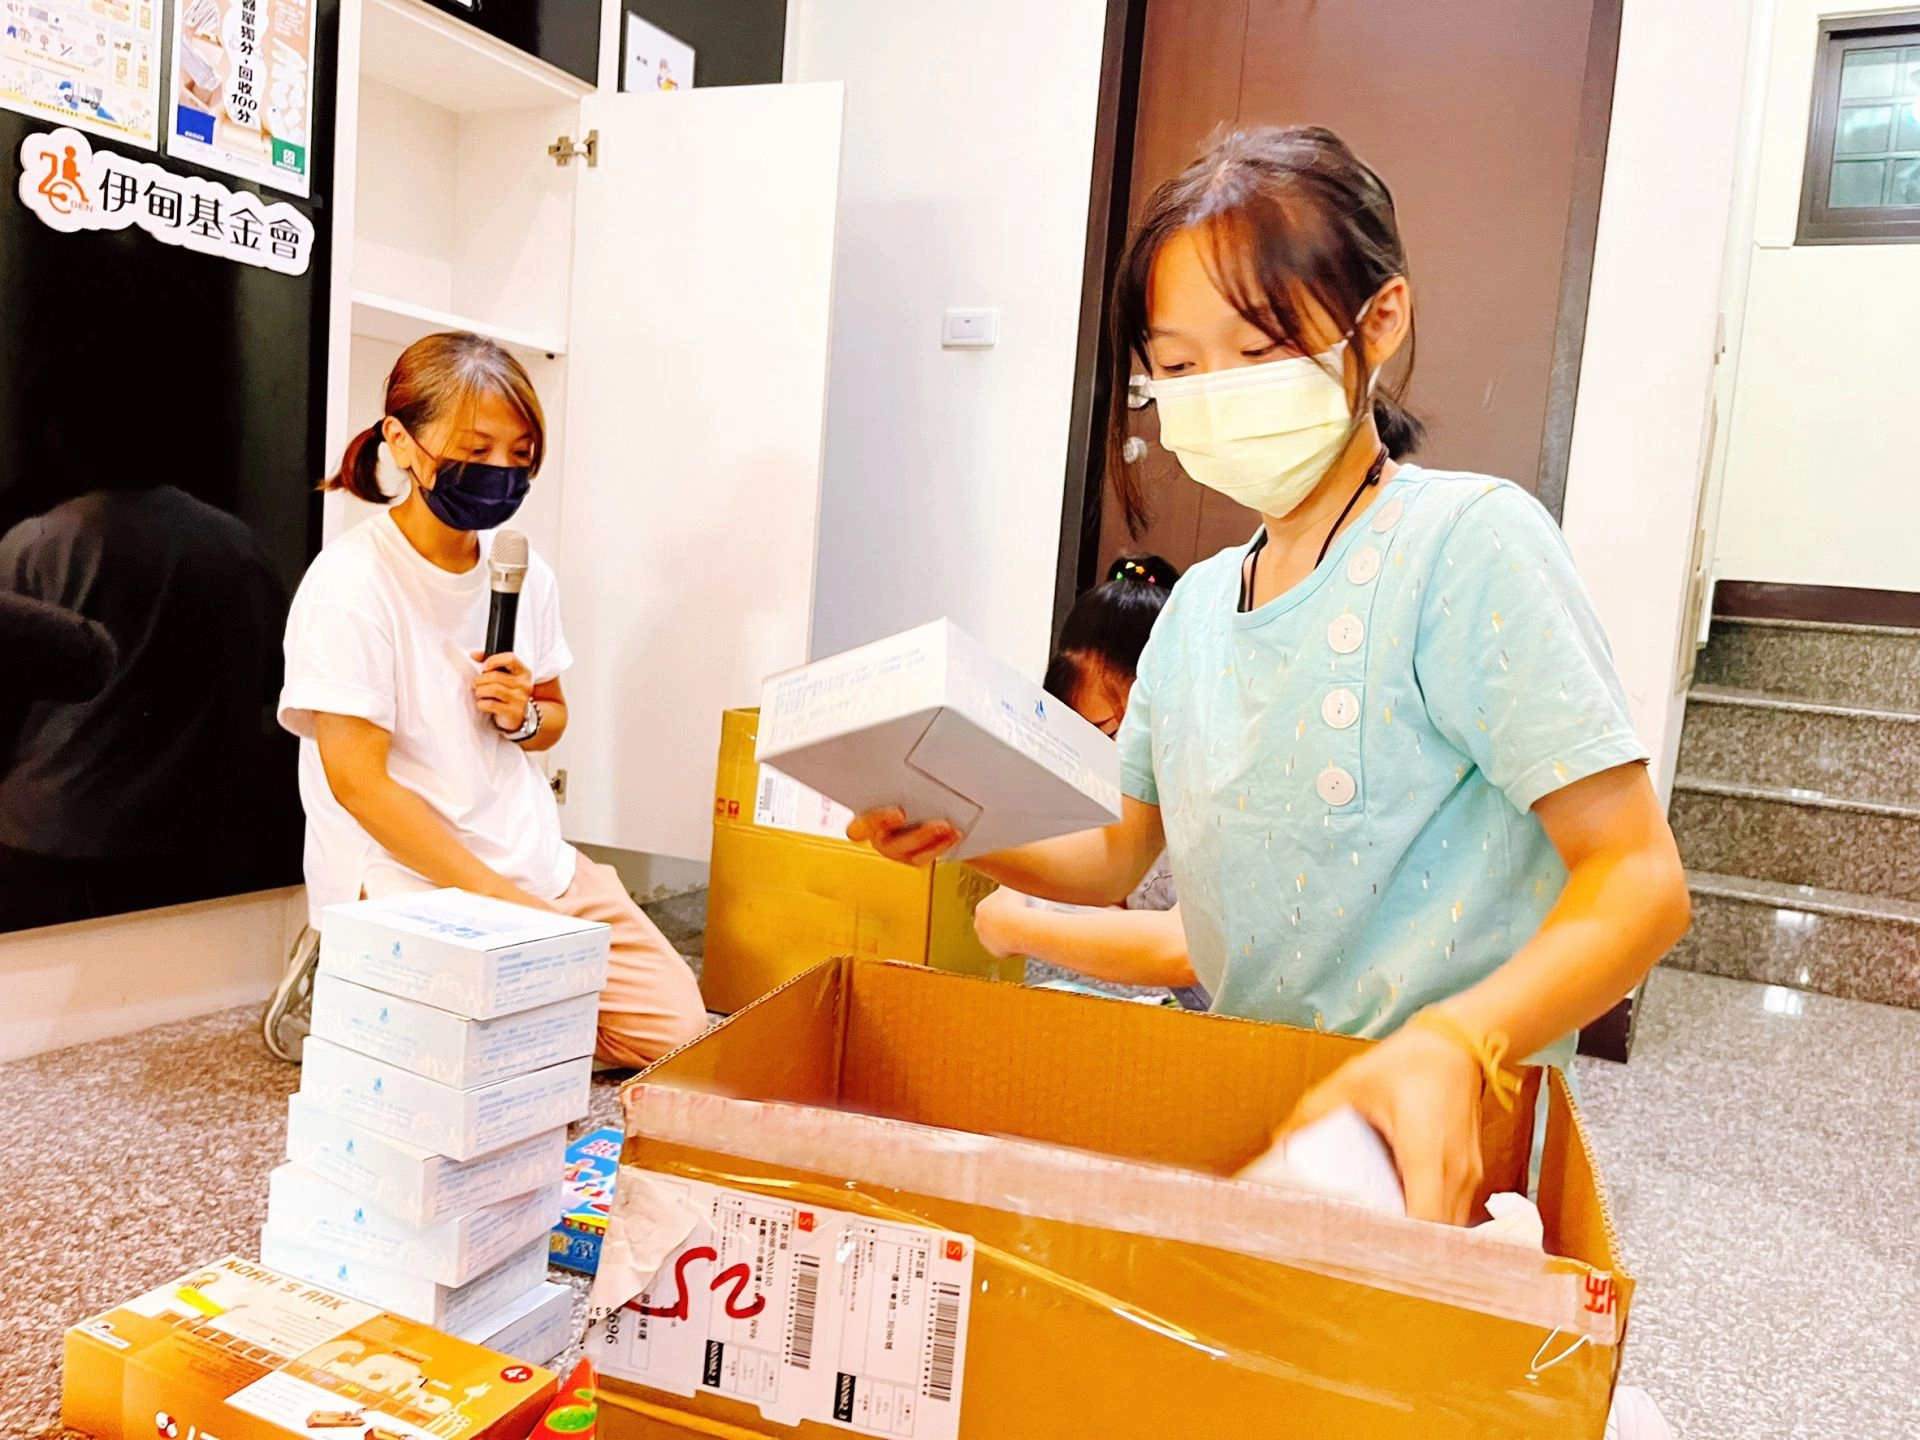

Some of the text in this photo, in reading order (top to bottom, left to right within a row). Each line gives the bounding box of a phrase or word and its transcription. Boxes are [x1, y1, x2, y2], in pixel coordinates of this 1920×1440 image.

[98, 167, 302, 260] 伊甸基金會
[299, 1290, 349, 1310] ARK
[504, 1367, 528, 1380] 4+
